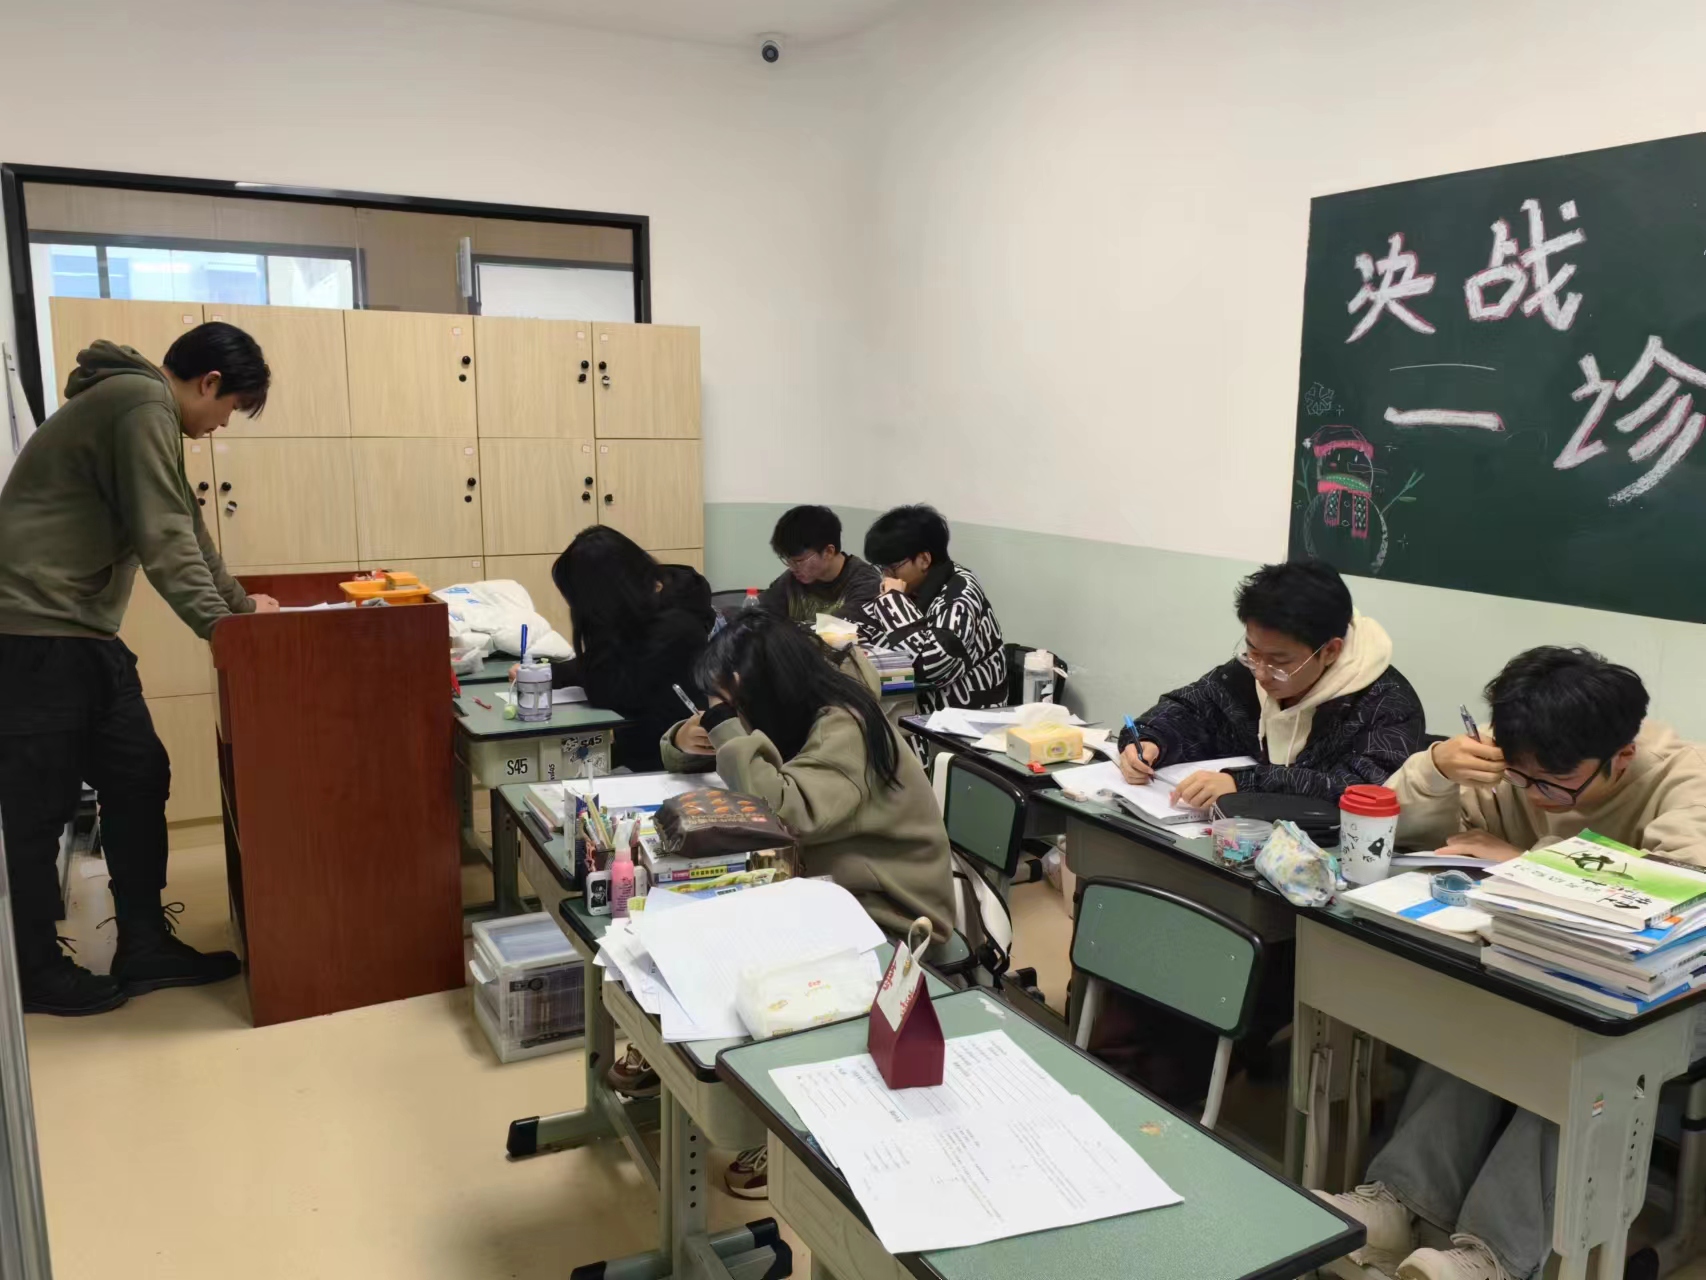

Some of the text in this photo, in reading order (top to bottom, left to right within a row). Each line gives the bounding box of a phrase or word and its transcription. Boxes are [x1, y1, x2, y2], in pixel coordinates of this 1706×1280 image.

[1345, 198, 1586, 343] 决战
[1384, 335, 1706, 506] 一诊
[507, 758, 528, 775] S45
